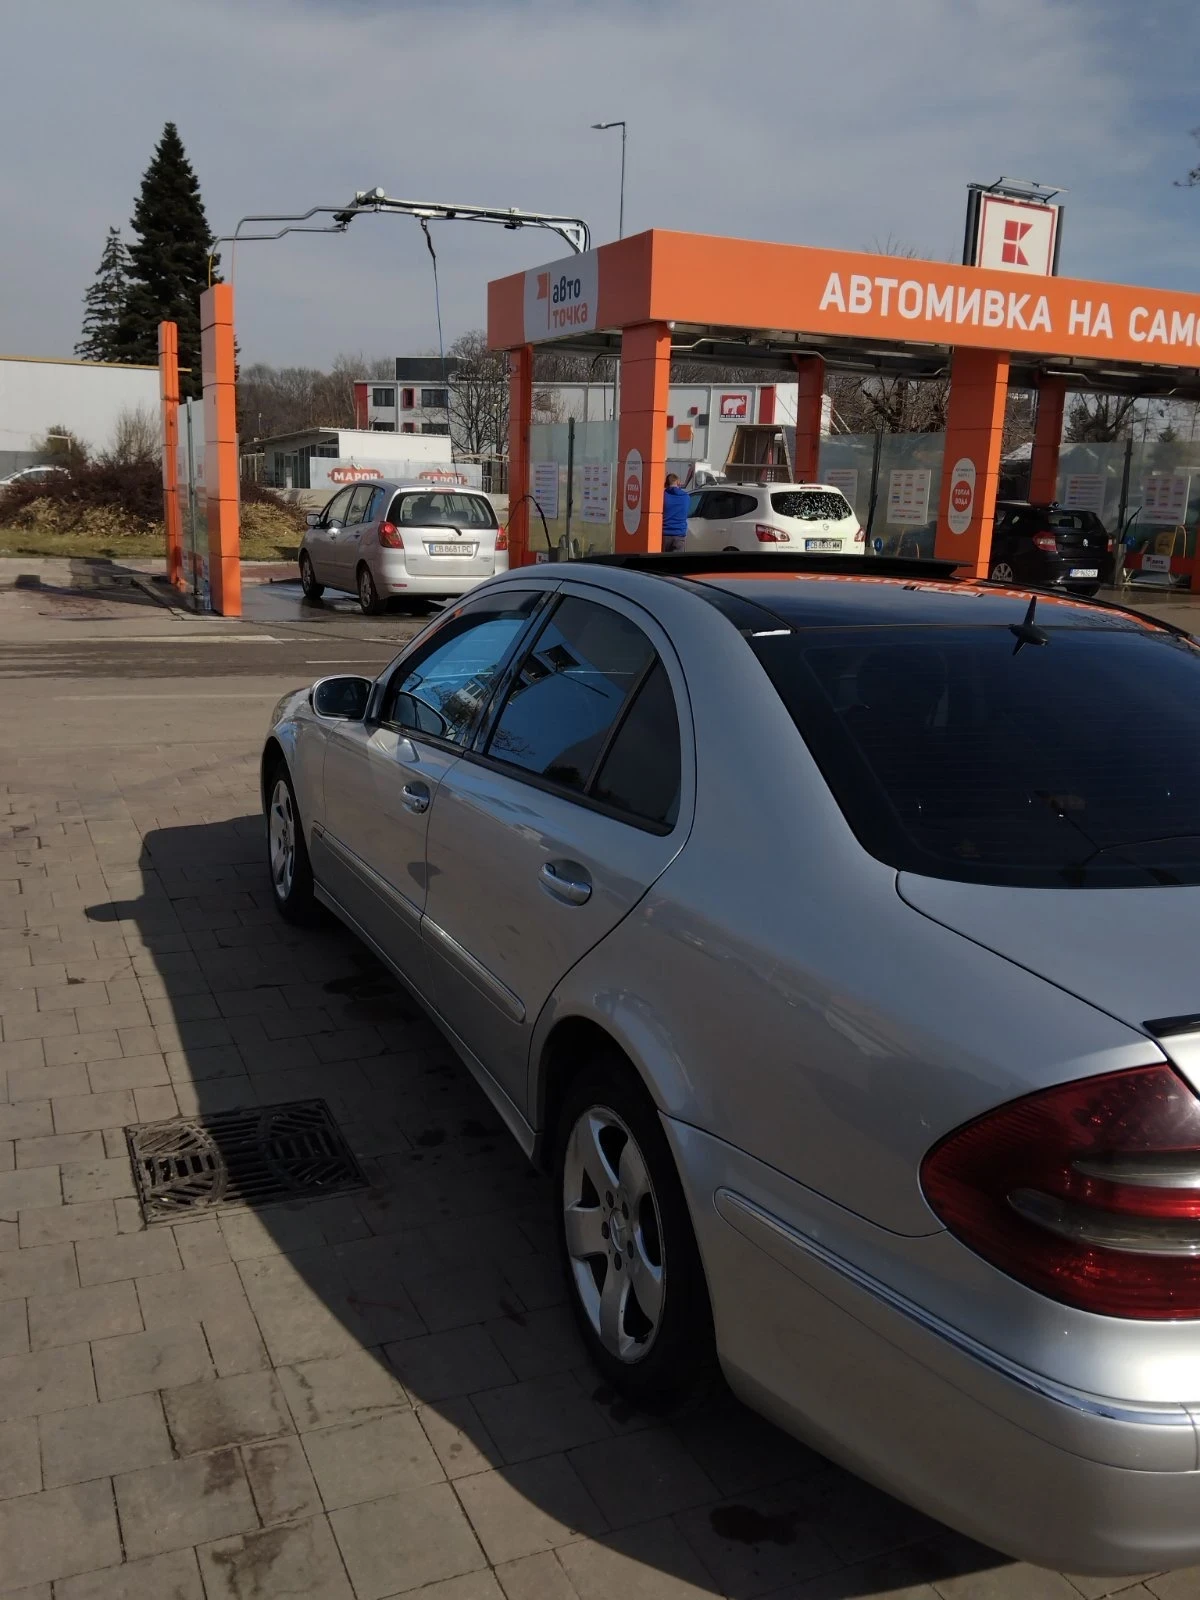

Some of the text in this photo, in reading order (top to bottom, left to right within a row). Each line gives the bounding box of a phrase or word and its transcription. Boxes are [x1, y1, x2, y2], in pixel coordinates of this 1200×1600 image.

[552, 275, 581, 303] авто
[552, 302, 588, 329] точка
[818, 272, 1200, 347] АВТОМИВКА НА САМ
[333, 471, 378, 481] МАРОН
